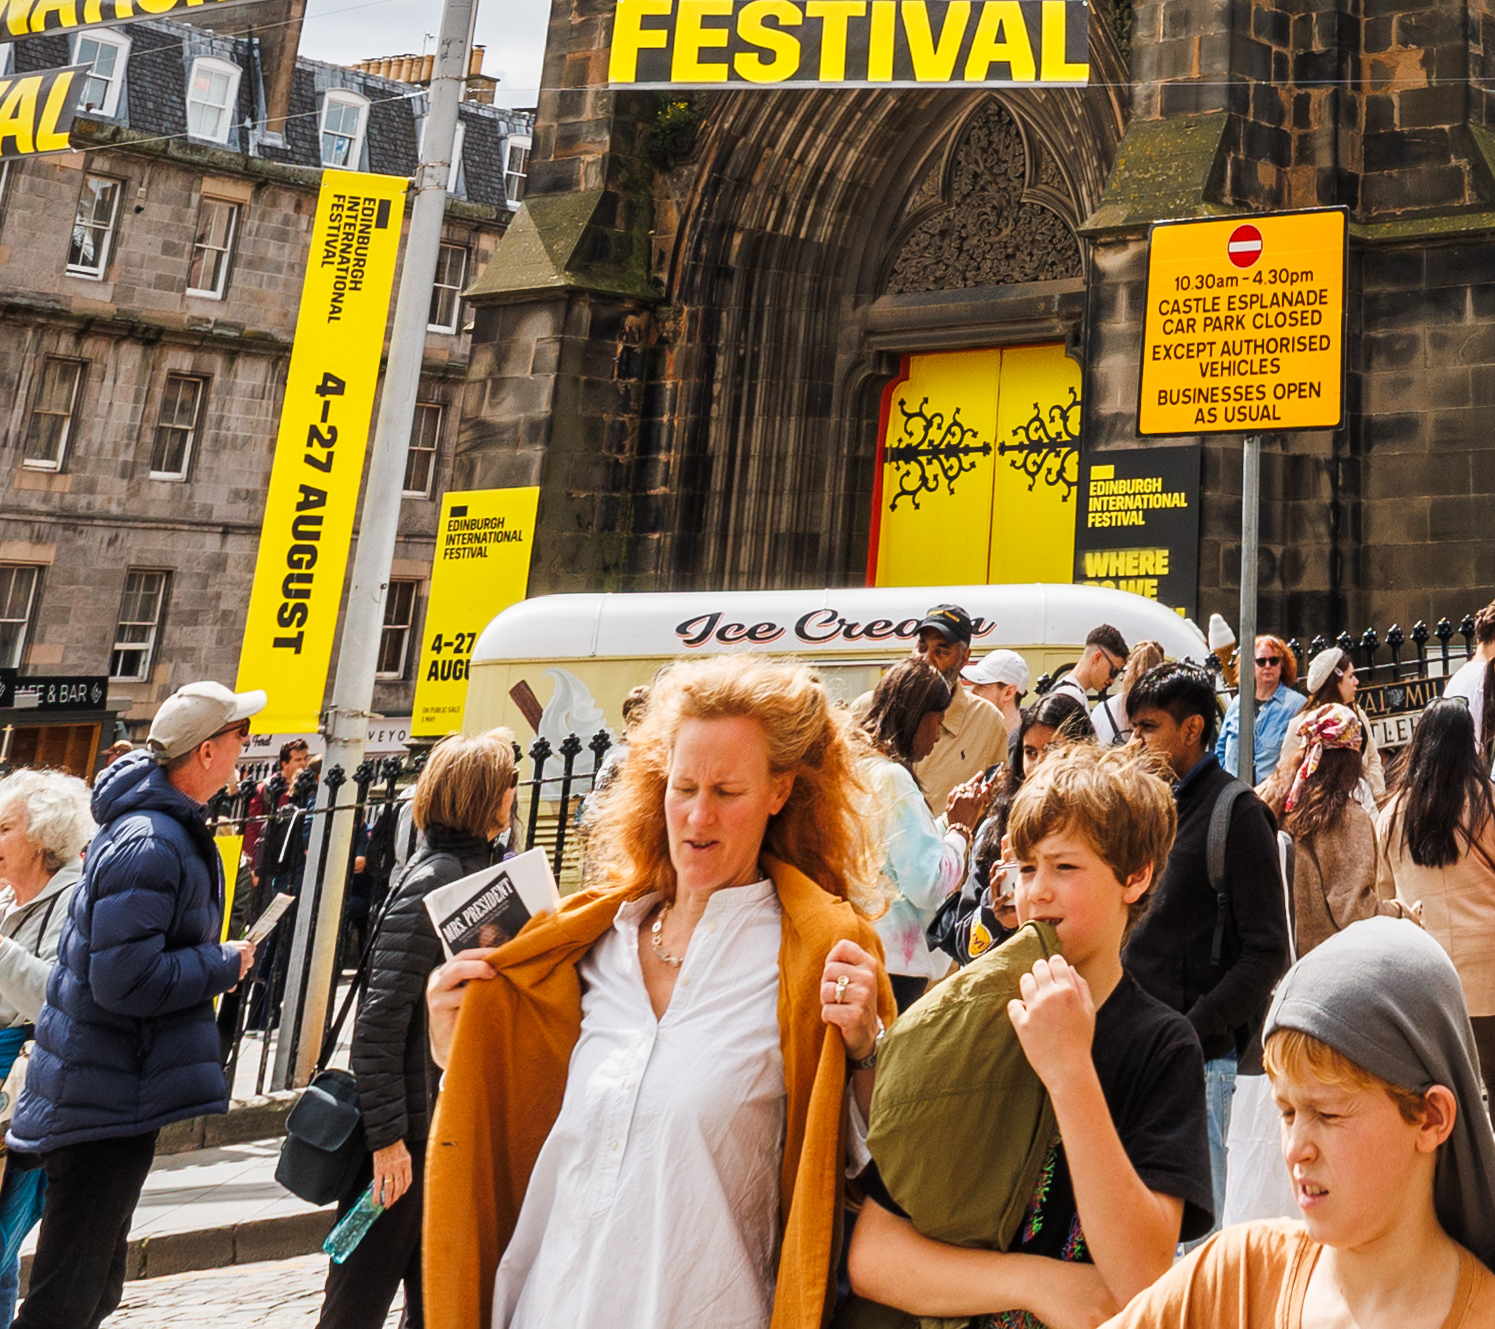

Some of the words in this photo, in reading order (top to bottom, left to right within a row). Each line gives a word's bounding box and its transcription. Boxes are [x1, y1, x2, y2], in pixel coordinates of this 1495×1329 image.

[320, 193, 346, 269] FESTIVAL
[348, 197, 376, 292] EDINBURGH
[327, 195, 362, 324] INTERNATIONAL
[1174, 273, 1239, 291] 10.30am
[1252, 268, 1314, 286] 4.30pm
[1158, 296, 1221, 316] CASTLE
[1227, 288, 1328, 311] ESPLANADE
[1162, 318, 1196, 335] CAR
[1203, 314, 1247, 332] PARK
[1252, 309, 1322, 330] CLOSED
[1152, 341, 1217, 361] EXCEPT
[1220, 334, 1331, 357] AUTHORISED
[1199, 357, 1281, 378] VEHICLES
[1157, 384, 1266, 406] BUSINESSES
[1272, 381, 1322, 400] OPEN
[1194, 407, 1217, 425] AS
[1224, 404, 1281, 422] USUAL
[1089, 477, 1162, 496] EDINBURGH
[1088, 492, 1188, 512] INTERNATIONAL
[447, 517, 505, 532] EDINBURGH
[1087, 511, 1146, 528] FESTIVAL
[445, 530, 523, 546] INTERNATIONAL
[443, 545, 488, 560] FESTIVAL
[1084, 549, 1169, 578] WHERE
[272, 483, 328, 655] AUGUST
[675, 611, 787, 648] Ice
[47, 684, 57, 703] &
[59, 684, 87, 703] BAR
[442, 916, 468, 943] MRS.
[461, 876, 514, 927] PRESIDENT
